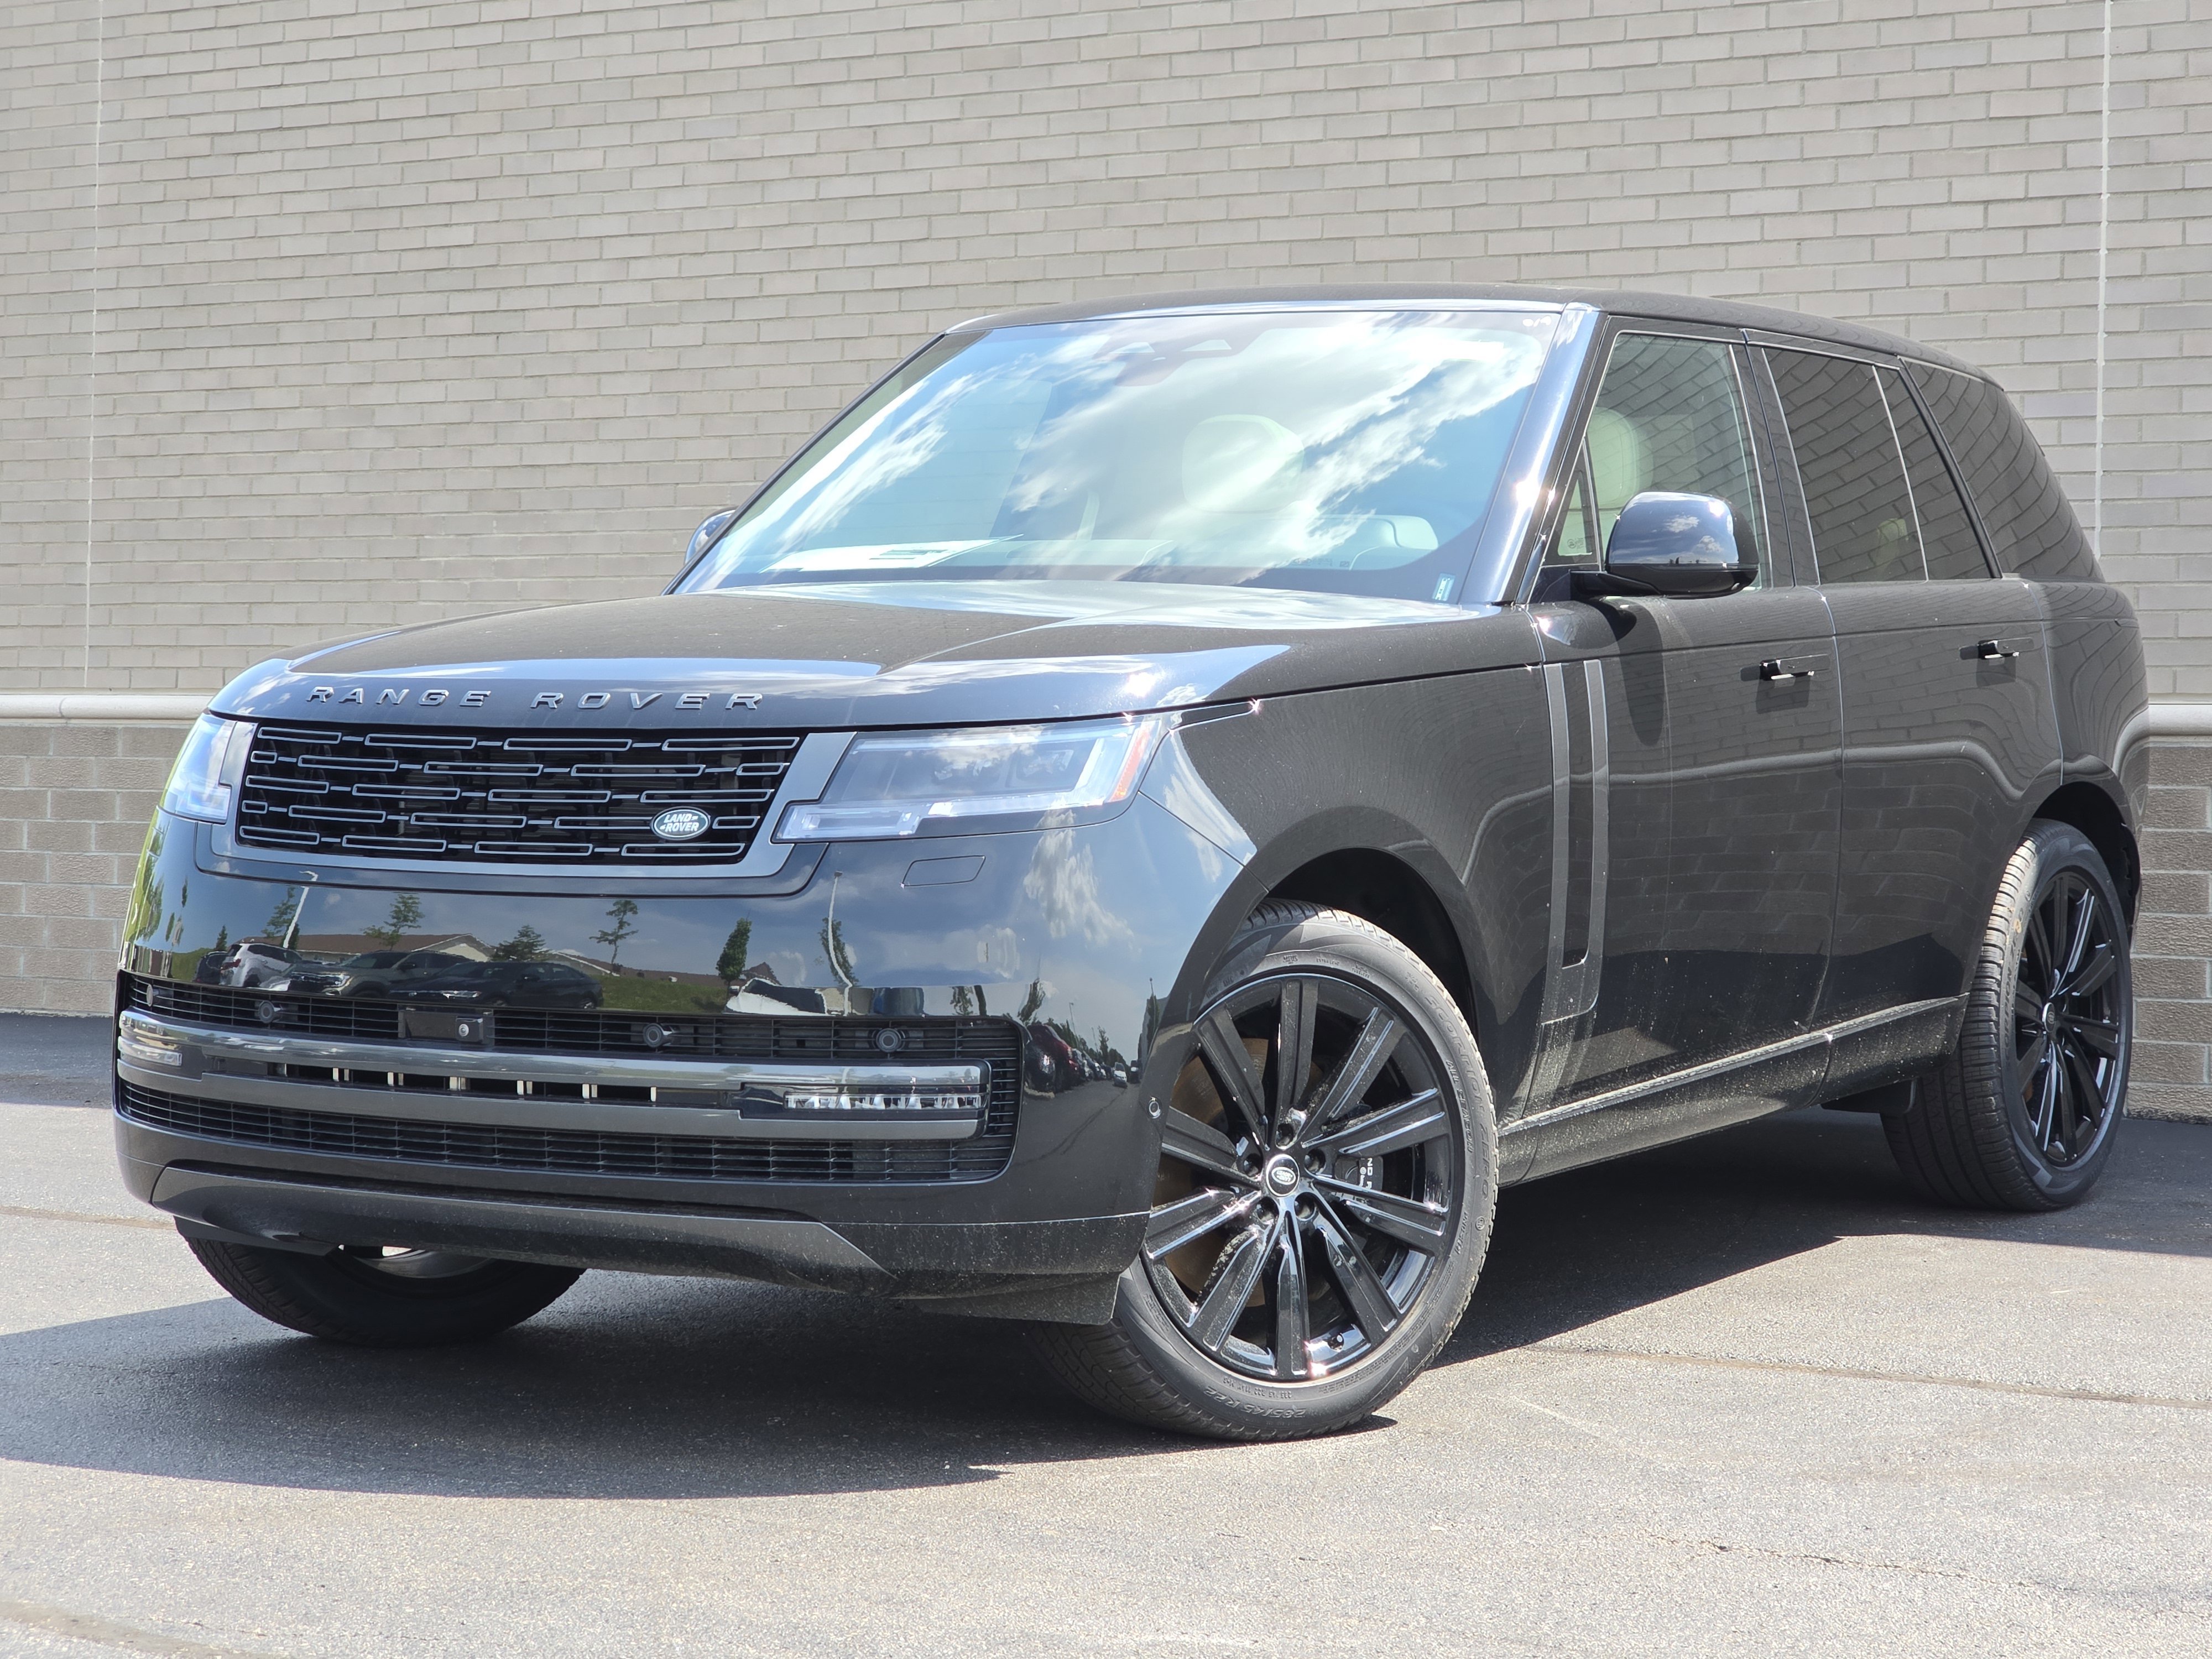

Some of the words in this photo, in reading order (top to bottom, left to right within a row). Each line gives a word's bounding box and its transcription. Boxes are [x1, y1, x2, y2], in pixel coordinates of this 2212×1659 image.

[305, 686, 492, 707] RANGE
[529, 692, 763, 710] ROVER
[664, 813, 692, 823] LAND
[664, 822, 700, 832] ROVER
[1425, 994, 1486, 1114] SCORPION
[1479, 1122, 1491, 1202] ZERO
[1445, 1060, 1460, 1084] ALL
[1456, 1087, 1474, 1154] SEASON
[1203, 1385, 1241, 1408] R22
[1241, 1404, 1307, 1418] 285/45
